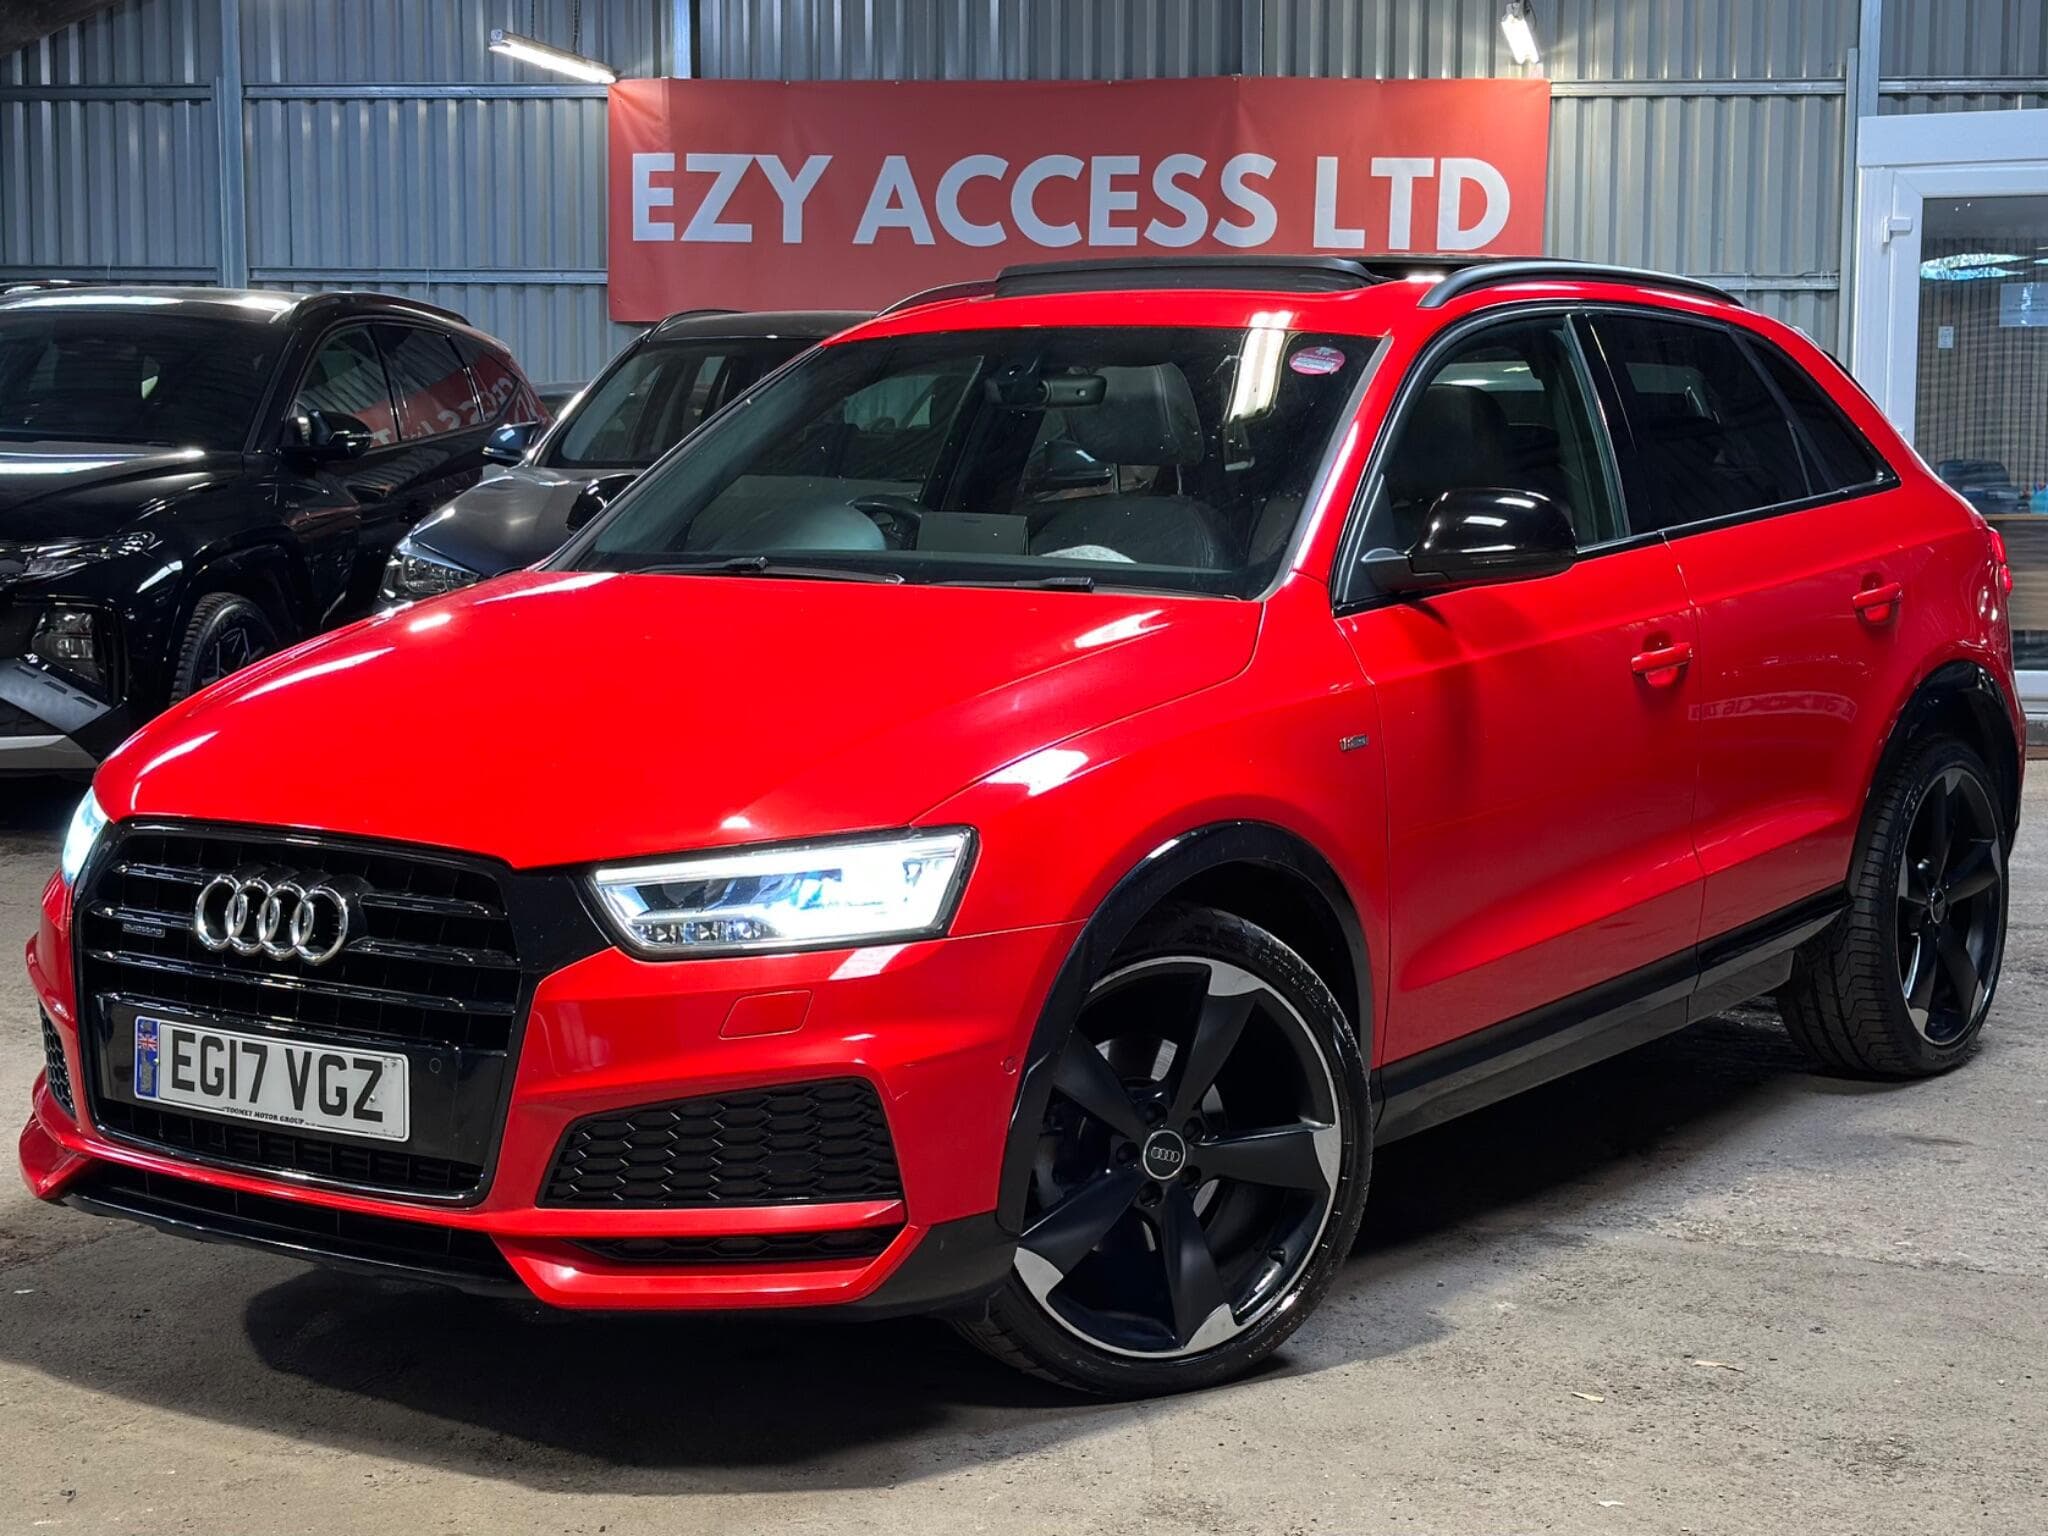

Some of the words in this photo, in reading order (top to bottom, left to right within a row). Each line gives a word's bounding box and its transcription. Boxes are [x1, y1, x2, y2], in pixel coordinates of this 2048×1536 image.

[632, 152, 833, 244] EZY
[853, 152, 1278, 249] ACCESS
[1313, 155, 1511, 251] LTD
[171, 1029, 269, 1104] EG17
[285, 1048, 383, 1123] VGZ
[254, 1111, 278, 1120] MOTOR
